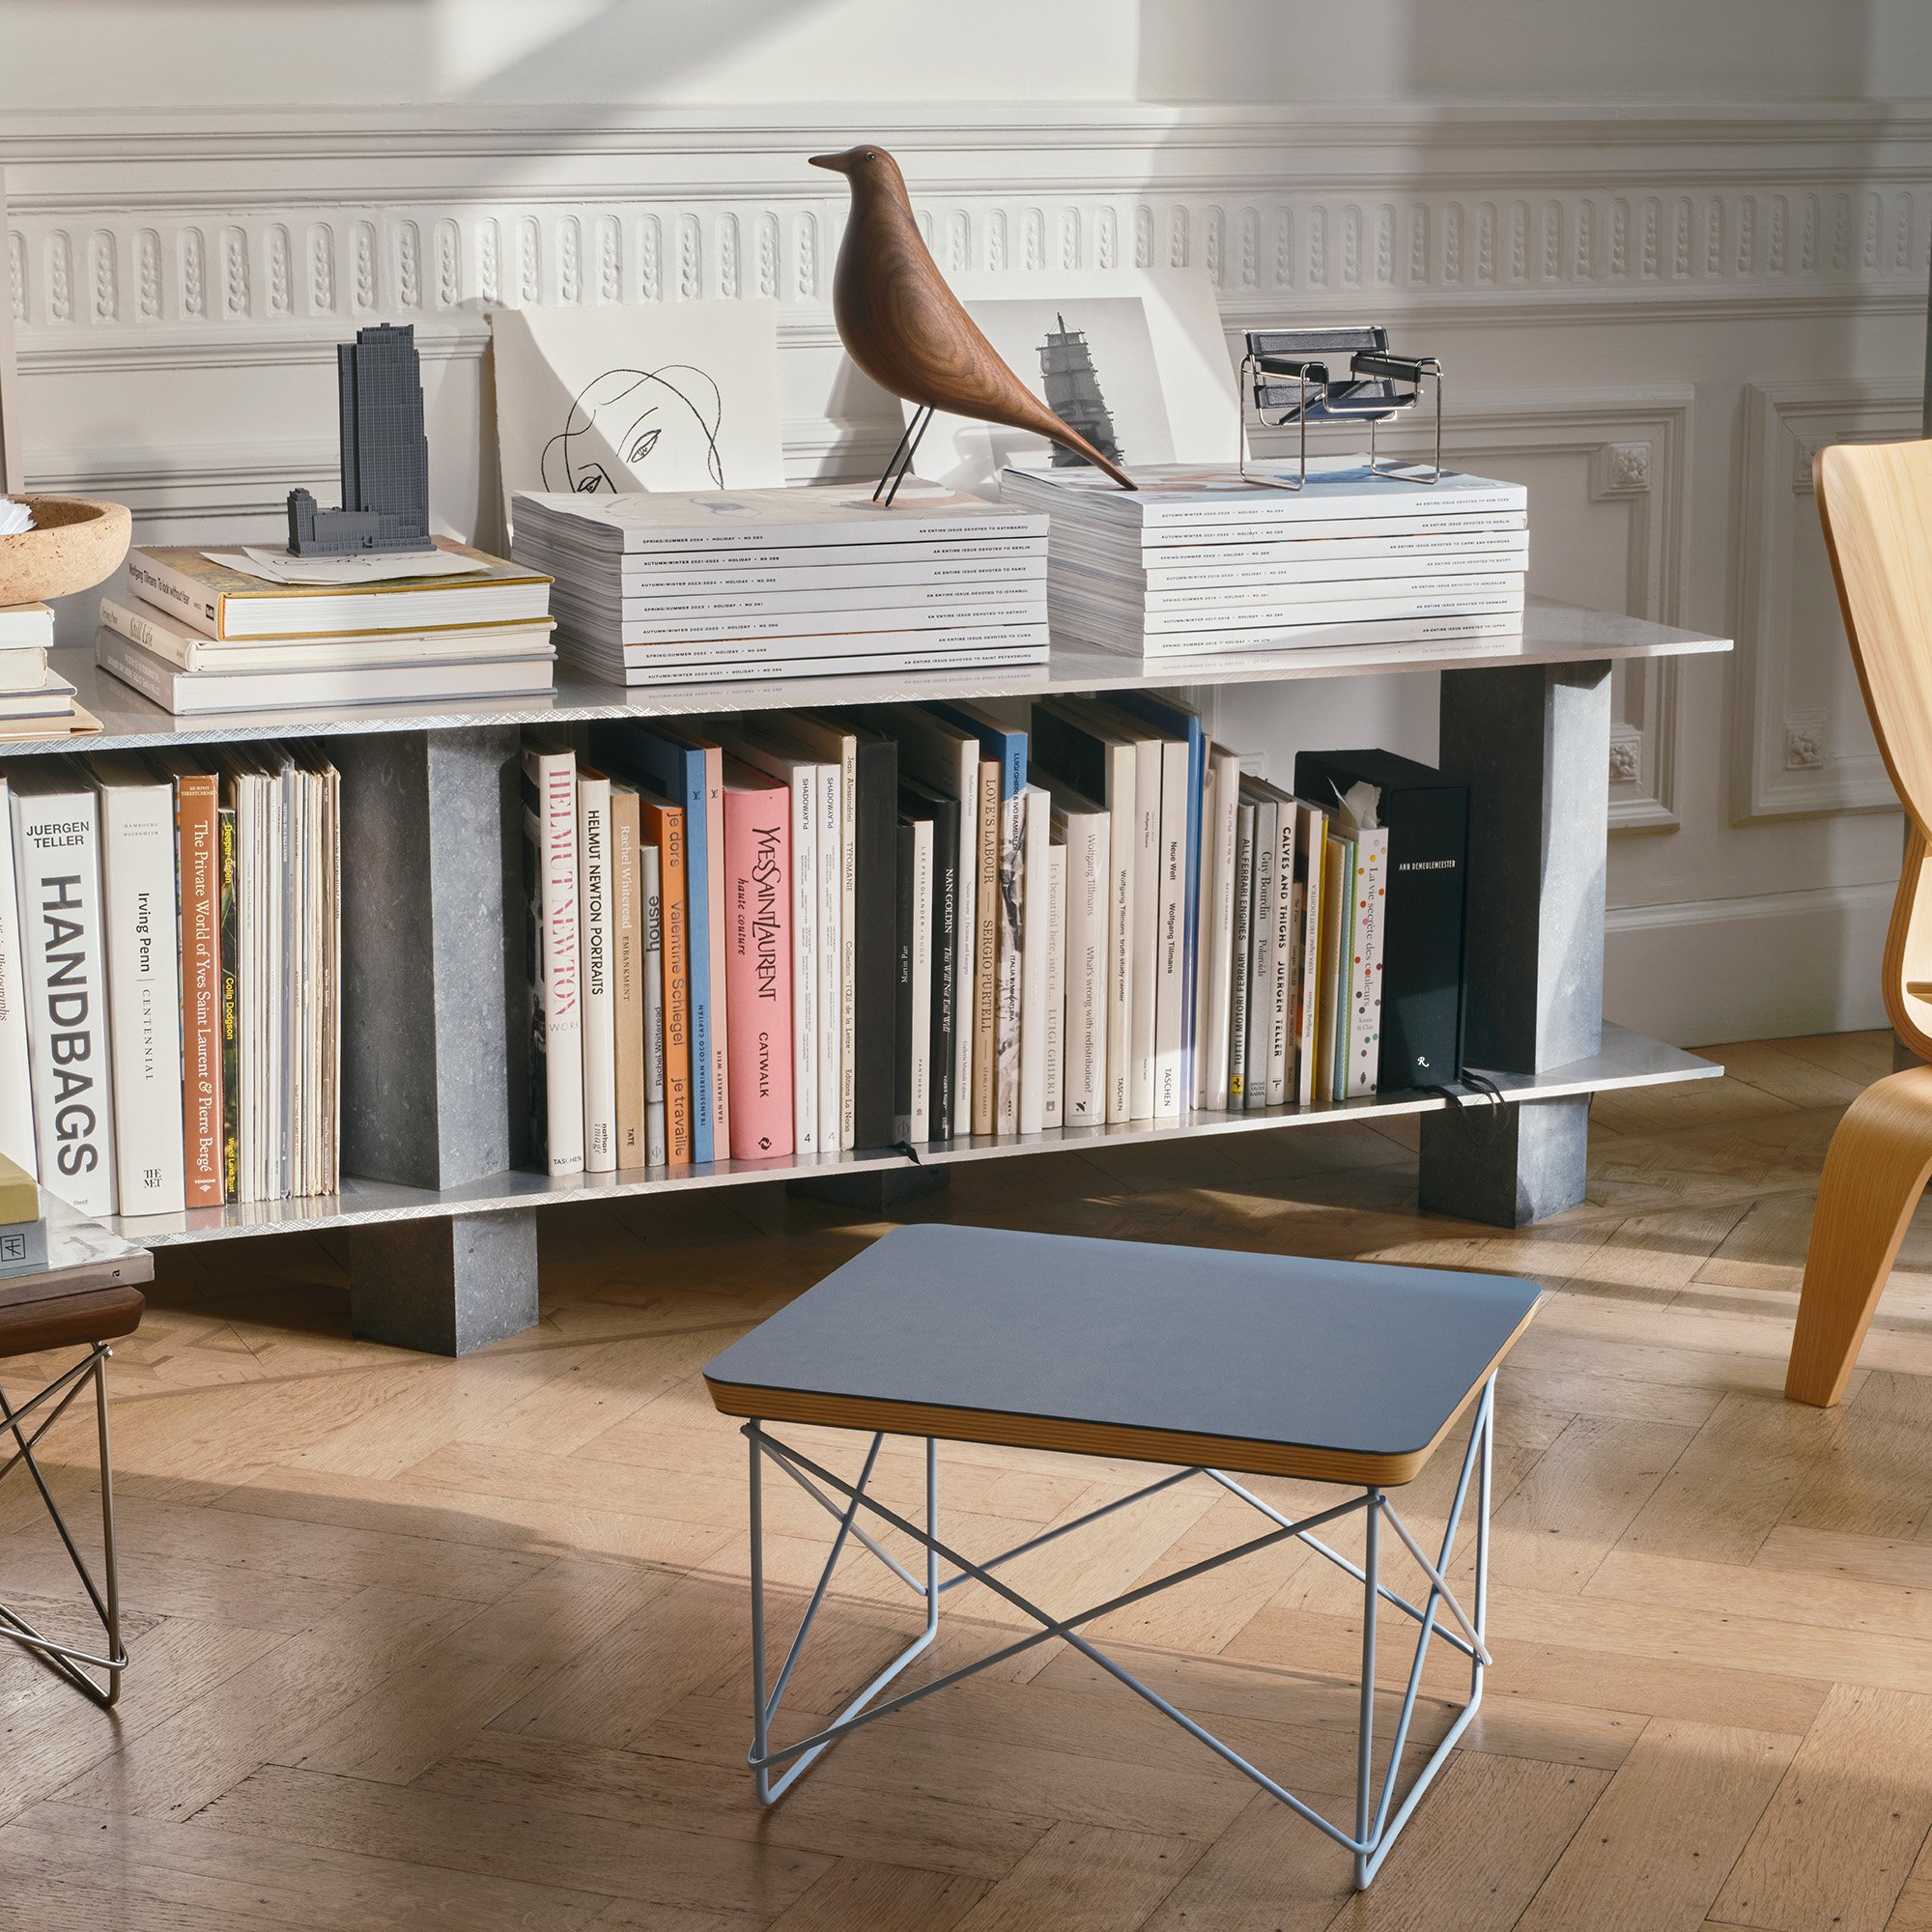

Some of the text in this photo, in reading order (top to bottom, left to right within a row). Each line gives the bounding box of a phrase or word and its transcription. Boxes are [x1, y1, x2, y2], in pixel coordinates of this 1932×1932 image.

[26, 821, 90, 837] JUERGEN
[34, 835, 84, 849] TELLER
[224, 824, 232, 884] Deeper Green
[620, 826, 631, 864] Rachel
[1085, 834, 1095, 877] Wolfgang
[549, 770, 576, 1016] HELMUT NEWTON
[945, 869, 953, 891] NAN
[1238, 838, 1250, 940] ALL FERRARI ENGINES
[1412, 860, 1455, 870] DEMEULEMEESTER
[588, 811, 603, 995] HELMUT NEWTON PORTRAITS
[622, 868, 633, 928] Whiteread
[646, 895, 660, 952] house
[738, 878, 749, 955] haute couture
[944, 894, 953, 933] GOLDIN
[981, 779, 996, 1033] LOVE'S LABOUR SERGIO PURTELL
[1050, 882, 1059, 929] beautiful
[1087, 879, 1095, 916] Tillmans
[1167, 903, 1176, 939] Wolfgang
[1258, 852, 1272, 977] Guy Bourdin Polaroids
[1366, 868, 1378, 960] La vie secrète des
[1048, 932, 1058, 955] here,
[1274, 827, 1291, 1057] CALVES AND THIGHS JUERGEN TELLER
[136, 893, 154, 1081] Irving Penn CENTENNIAL
[194, 820, 213, 1172] The Private World of Yves Saint Laurent & Pierre Bergé
[225, 977, 234, 1040] Colin Dodgson
[667, 812, 687, 1156] je dors Valentine Schlegel je travaille
[846, 1006, 852, 1014] de
[1084, 979, 1092, 1008] wrong
[1234, 953, 1246, 1065] TUTTI MOTORI FERRARI
[42, 874, 99, 1176] HANDBAGS
[1048, 1009, 1056, 1044] LUIGI
[1085, 1009, 1094, 1029] with
[759, 1032, 769, 1098] CATWALK
[1047, 1049, 1056, 1094] GHIRRI
[1084, 1031, 1093, 1093] redistribution?
[1163, 1068, 1172, 1106] TASCHEN
[143, 1168, 162, 1179] THE
